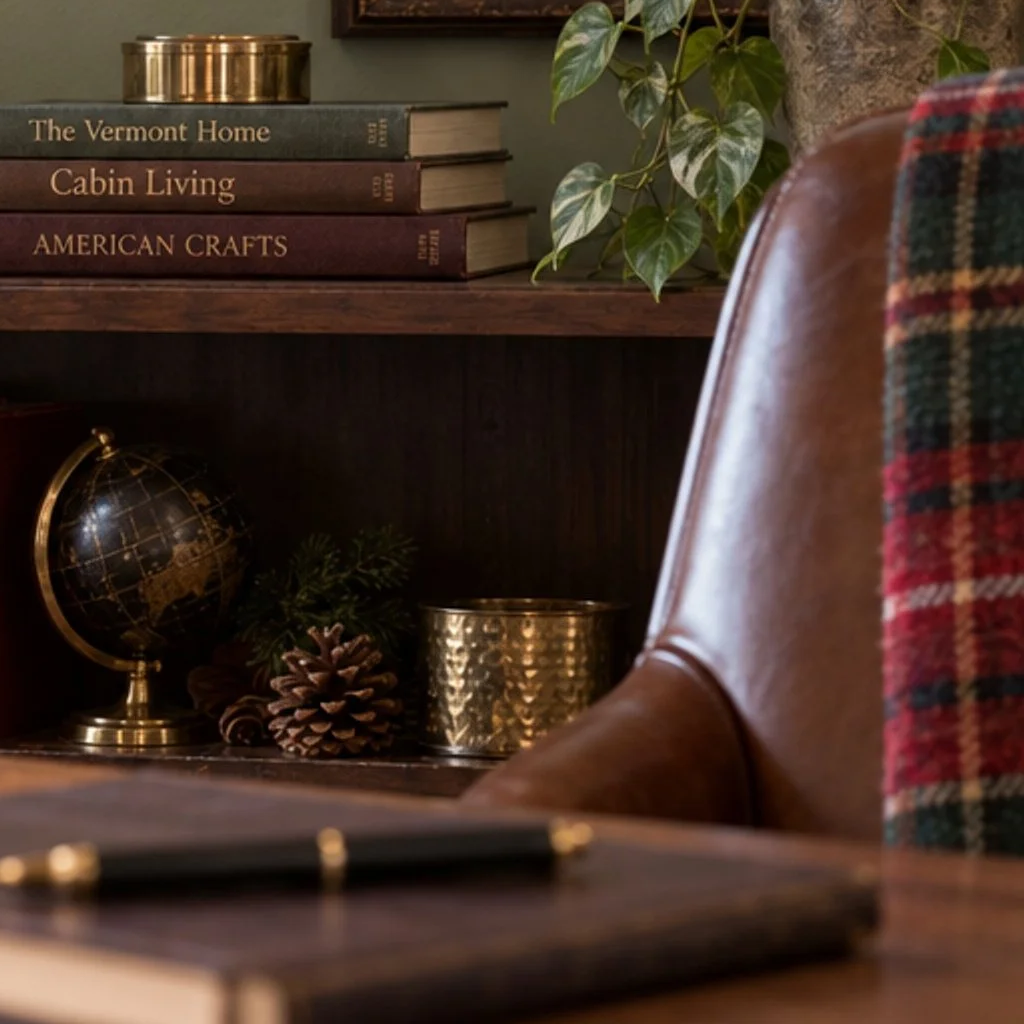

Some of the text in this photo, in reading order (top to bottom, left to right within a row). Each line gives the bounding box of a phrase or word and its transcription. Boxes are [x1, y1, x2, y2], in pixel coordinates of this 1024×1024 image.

[28, 118, 271, 143] The Vermont Home
[50, 167, 236, 205] Cabin Living
[32, 233, 288, 257] AMERICAN CRAFTS
